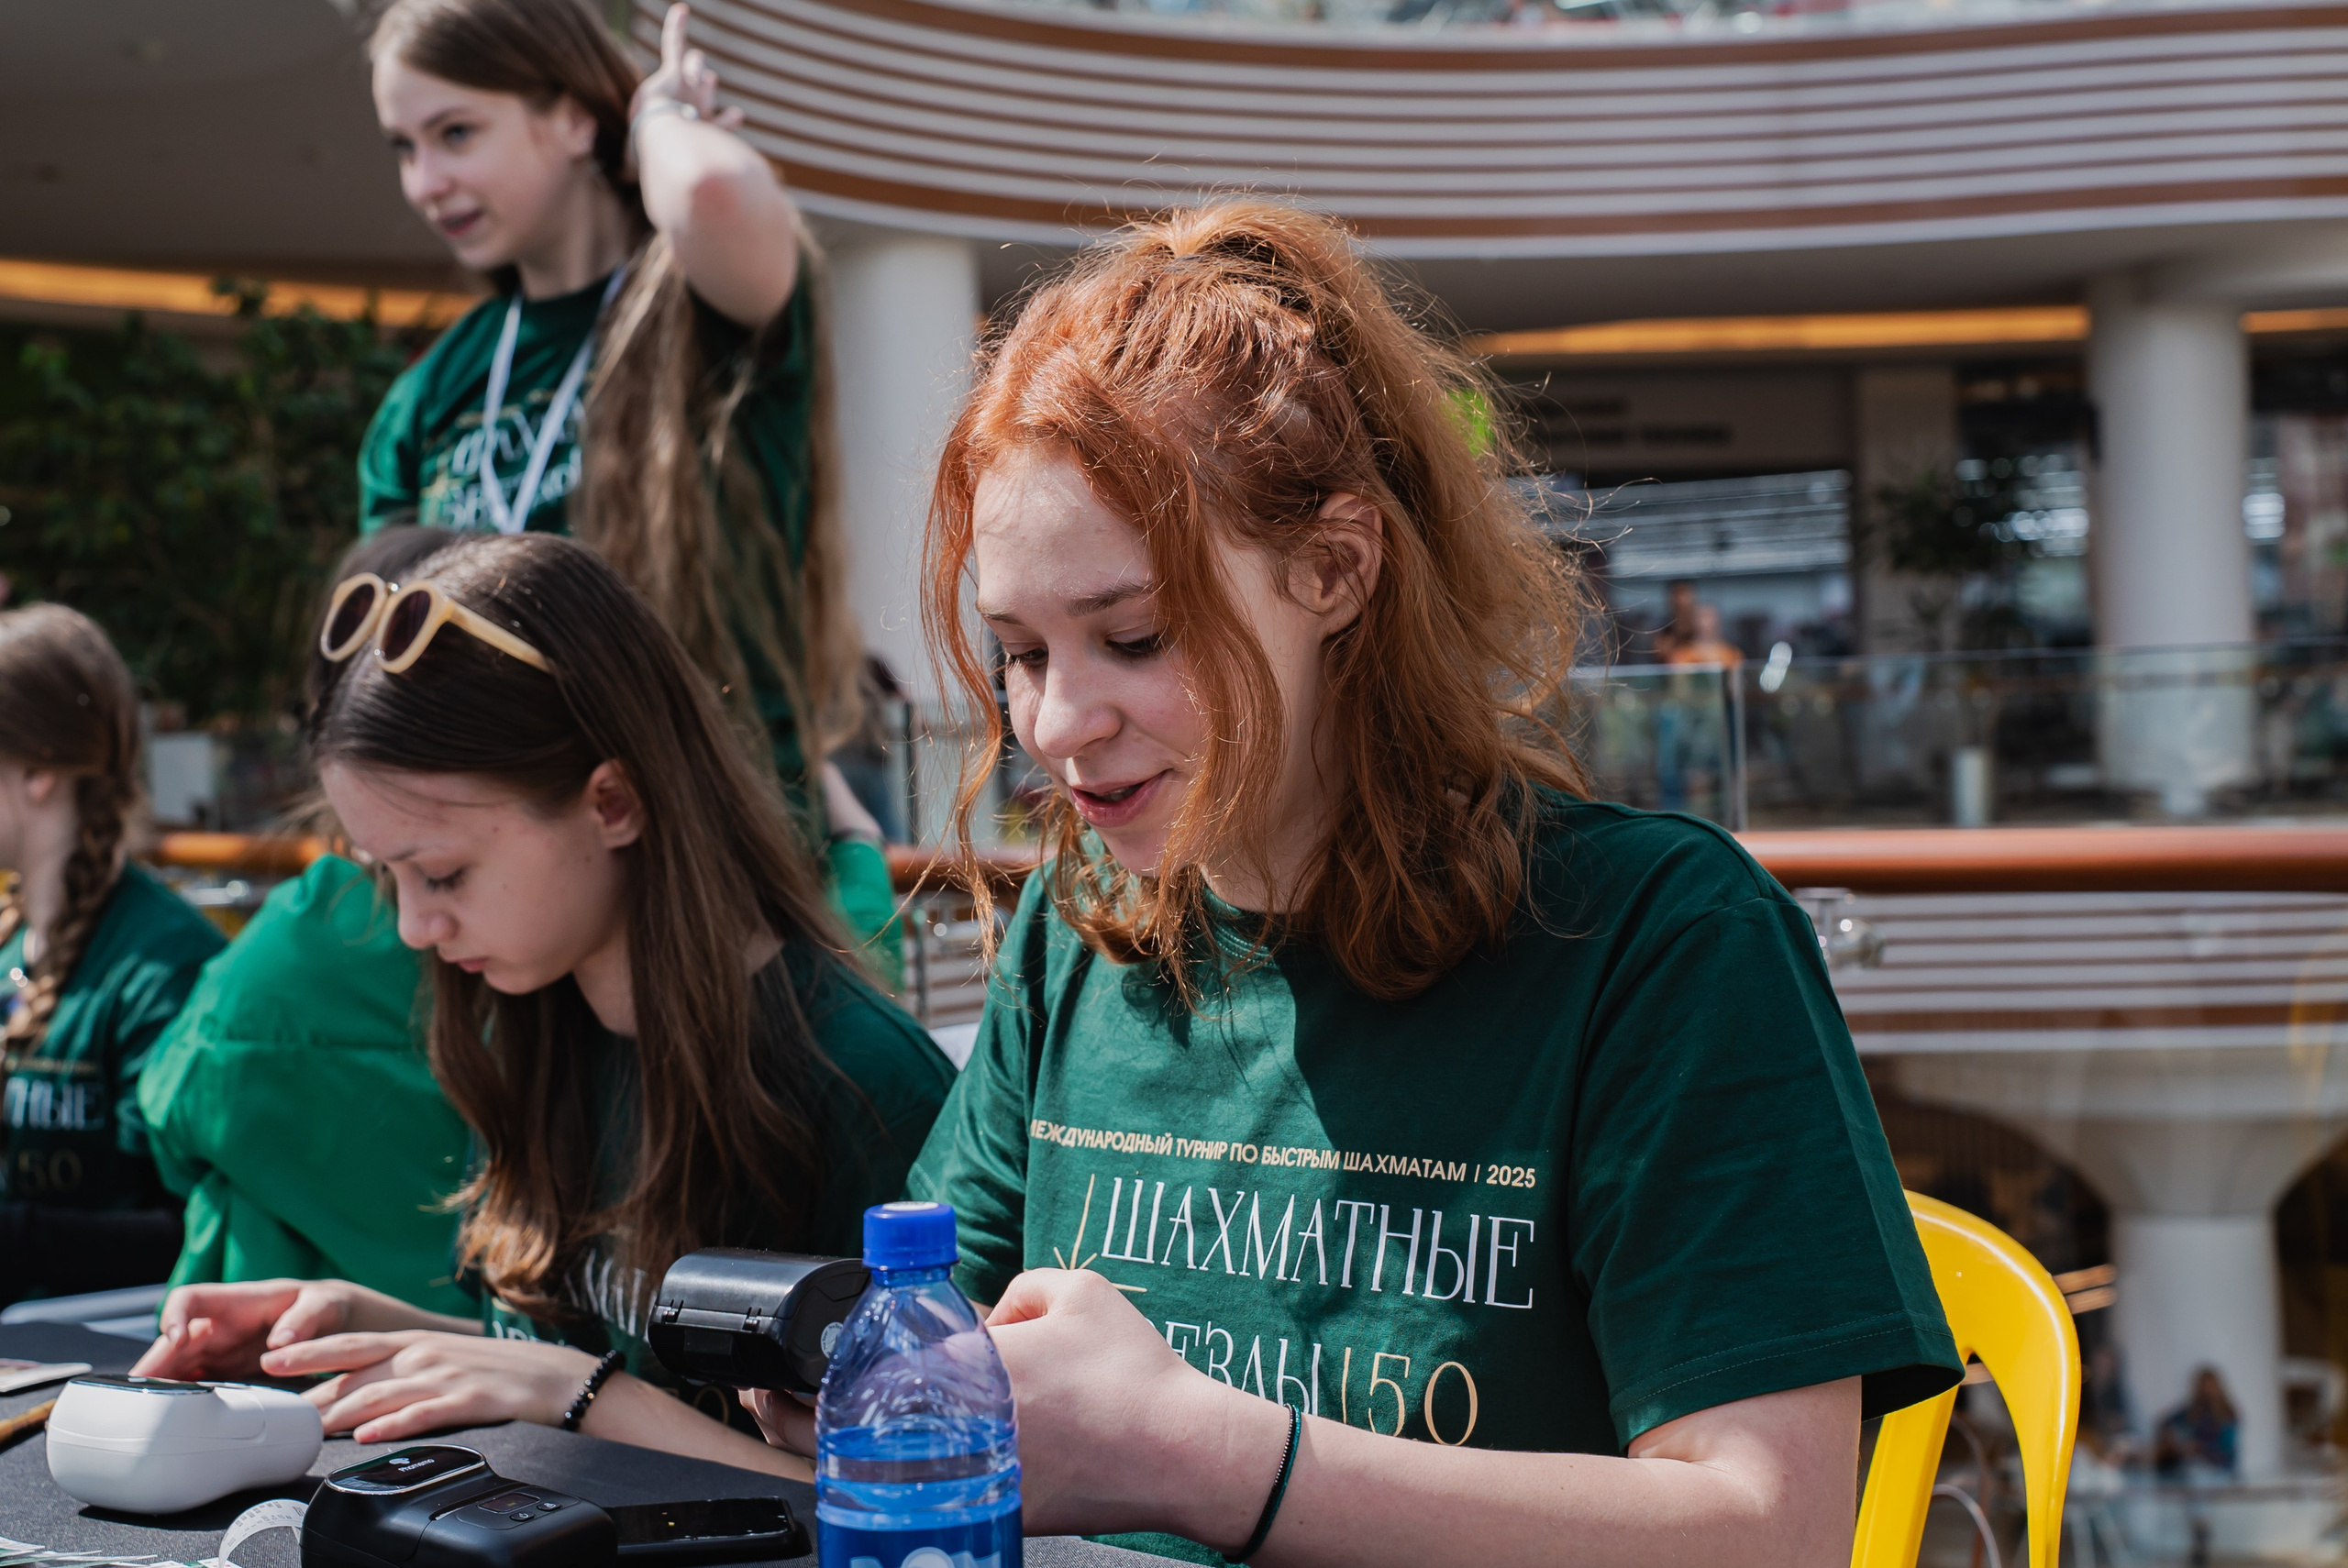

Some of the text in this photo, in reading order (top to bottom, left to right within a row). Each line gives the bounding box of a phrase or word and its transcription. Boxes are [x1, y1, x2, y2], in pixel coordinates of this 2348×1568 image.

[1176, 1137, 1228, 1160] ТУРНИР
[1229, 1143, 1258, 1164] ПО
[1261, 1145, 1341, 1170] БЫСТРЫМ
[1343, 1151, 1468, 1182] ШАХМАТАМ
[1486, 1164, 1536, 1188] 2025
[1101, 1176, 1535, 1309] ШАХМАТНЫЕ
